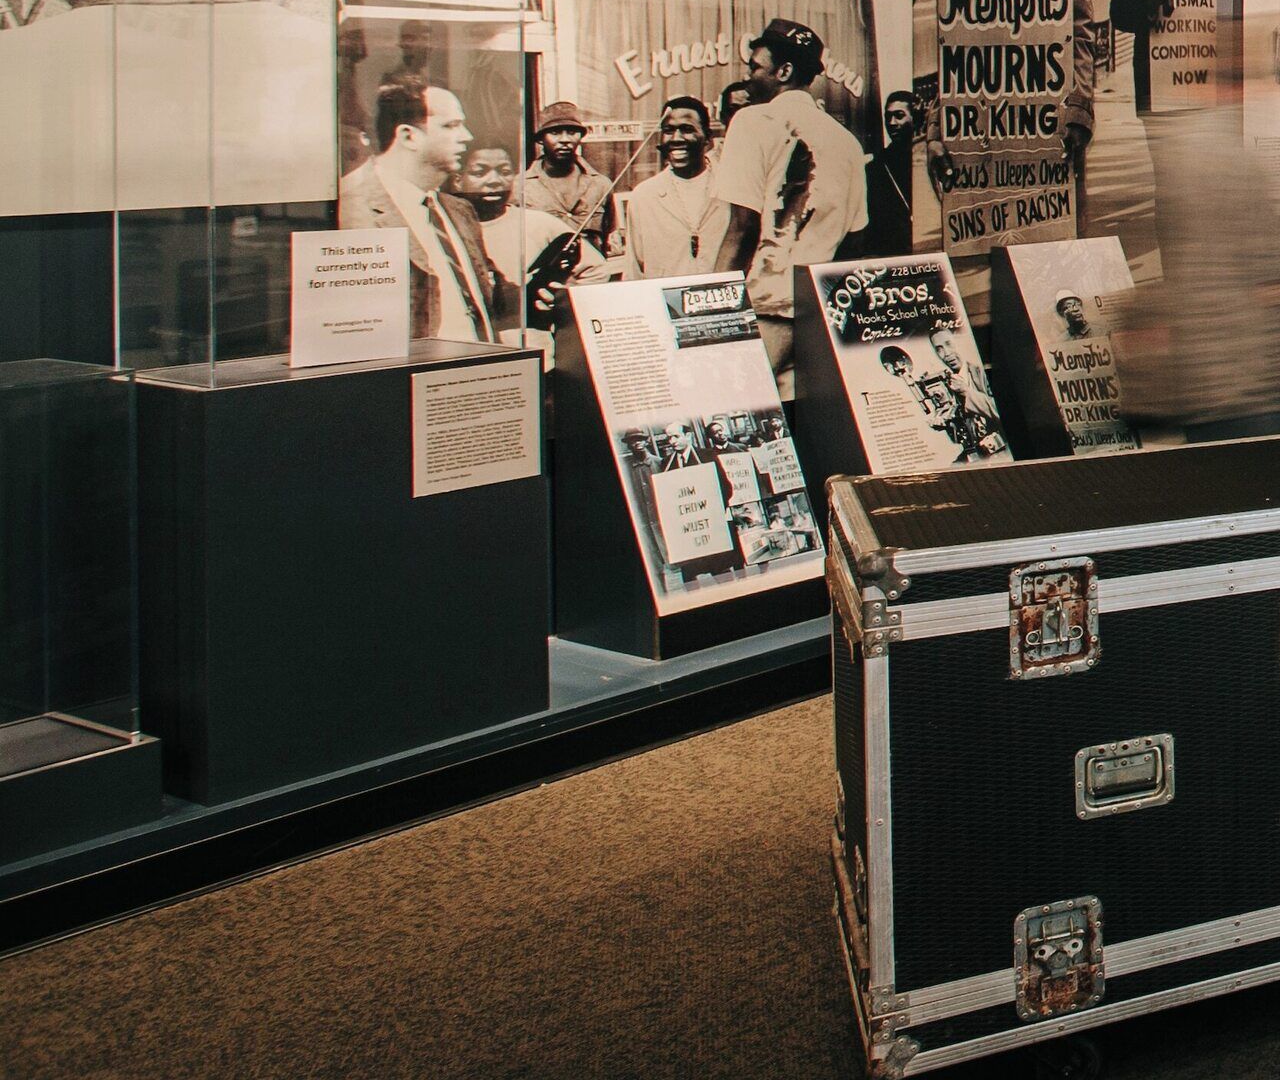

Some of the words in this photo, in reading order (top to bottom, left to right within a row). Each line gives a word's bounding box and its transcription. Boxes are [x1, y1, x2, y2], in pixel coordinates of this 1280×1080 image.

[1152, 19, 1217, 34] WORKING
[613, 32, 731, 100] Ernest
[1173, 70, 1208, 86] NOW
[990, 98, 1059, 138] KING
[995, 159, 1036, 189] Weeps
[948, 207, 986, 243] SINS
[991, 202, 1010, 232] OF
[1016, 189, 1070, 227] RACISM
[321, 247, 345, 256] This
[347, 245, 374, 255] item
[376, 244, 385, 253] is
[315, 261, 369, 273] currently
[371, 260, 390, 270] out
[891, 267, 909, 277] 228
[910, 262, 943, 275] Linden
[308, 279, 329, 289] for
[329, 276, 397, 288] renovations
[865, 282, 934, 310] Bros.
[886, 306, 918, 321] School
[920, 306, 928, 315] of
[1049, 343, 1112, 374] Memphis
[1086, 404, 1120, 422] KING
[677, 484, 697, 499] JIM
[678, 499, 708, 516] CROW
[682, 518, 710, 534] MUST
